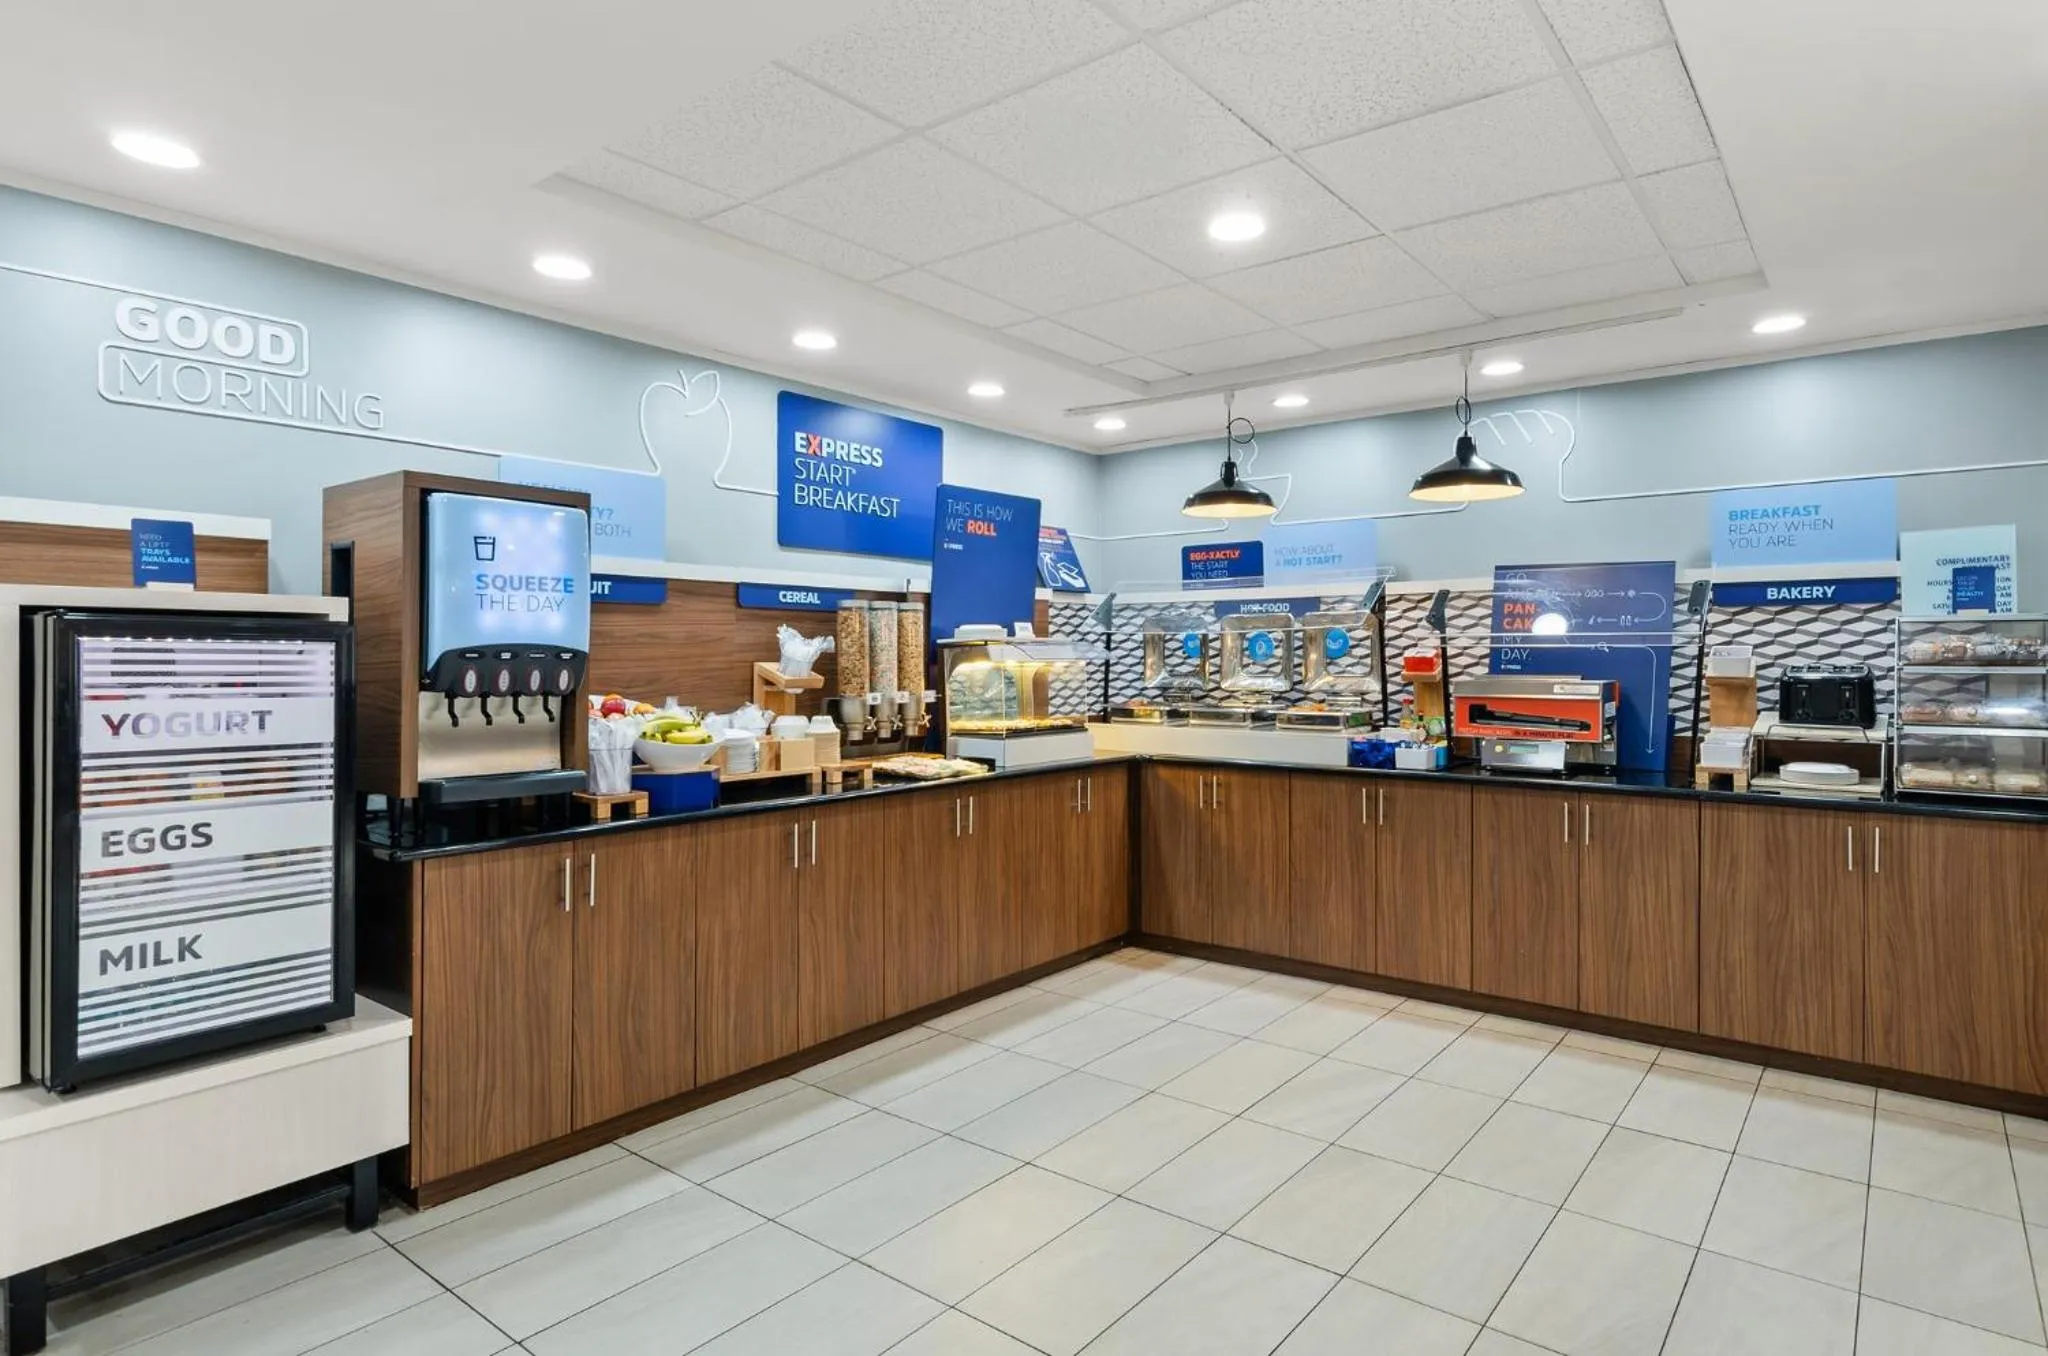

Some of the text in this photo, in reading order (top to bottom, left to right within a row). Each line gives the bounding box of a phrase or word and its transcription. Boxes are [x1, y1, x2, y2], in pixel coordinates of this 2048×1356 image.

[115, 299, 296, 365] GOOD
[119, 352, 384, 430] MORNING
[794, 431, 883, 467] EXPRESS
[794, 457, 854, 487] START
[794, 483, 901, 518] BREAKFAST
[947, 499, 1014, 522] THIS IS HOW
[1728, 505, 1821, 520] BREAKFAST
[594, 522, 631, 538] BOTH
[945, 516, 997, 537] WE ROLL
[1728, 518, 1834, 536] READY WHEN
[1728, 534, 1797, 550] YOU ARE
[1190, 549, 1241, 561] EGG-XACTLY
[1283, 557, 1302, 567] HOT
[1305, 555, 1343, 566] START?
[1935, 554, 2011, 566] COMPLIMENTARY
[1191, 560, 1228, 571] THE START
[475, 573, 575, 594] SQUEEZE
[591, 581, 612, 595] UIT
[1766, 585, 1836, 600] BAKERY
[475, 593, 565, 612] THE DAY
[779, 590, 821, 604] CEREAL
[1503, 618, 1534, 630] CAK
[102, 710, 273, 738] YOGURT
[101, 821, 214, 858] EGGS
[99, 933, 202, 977] MILK
